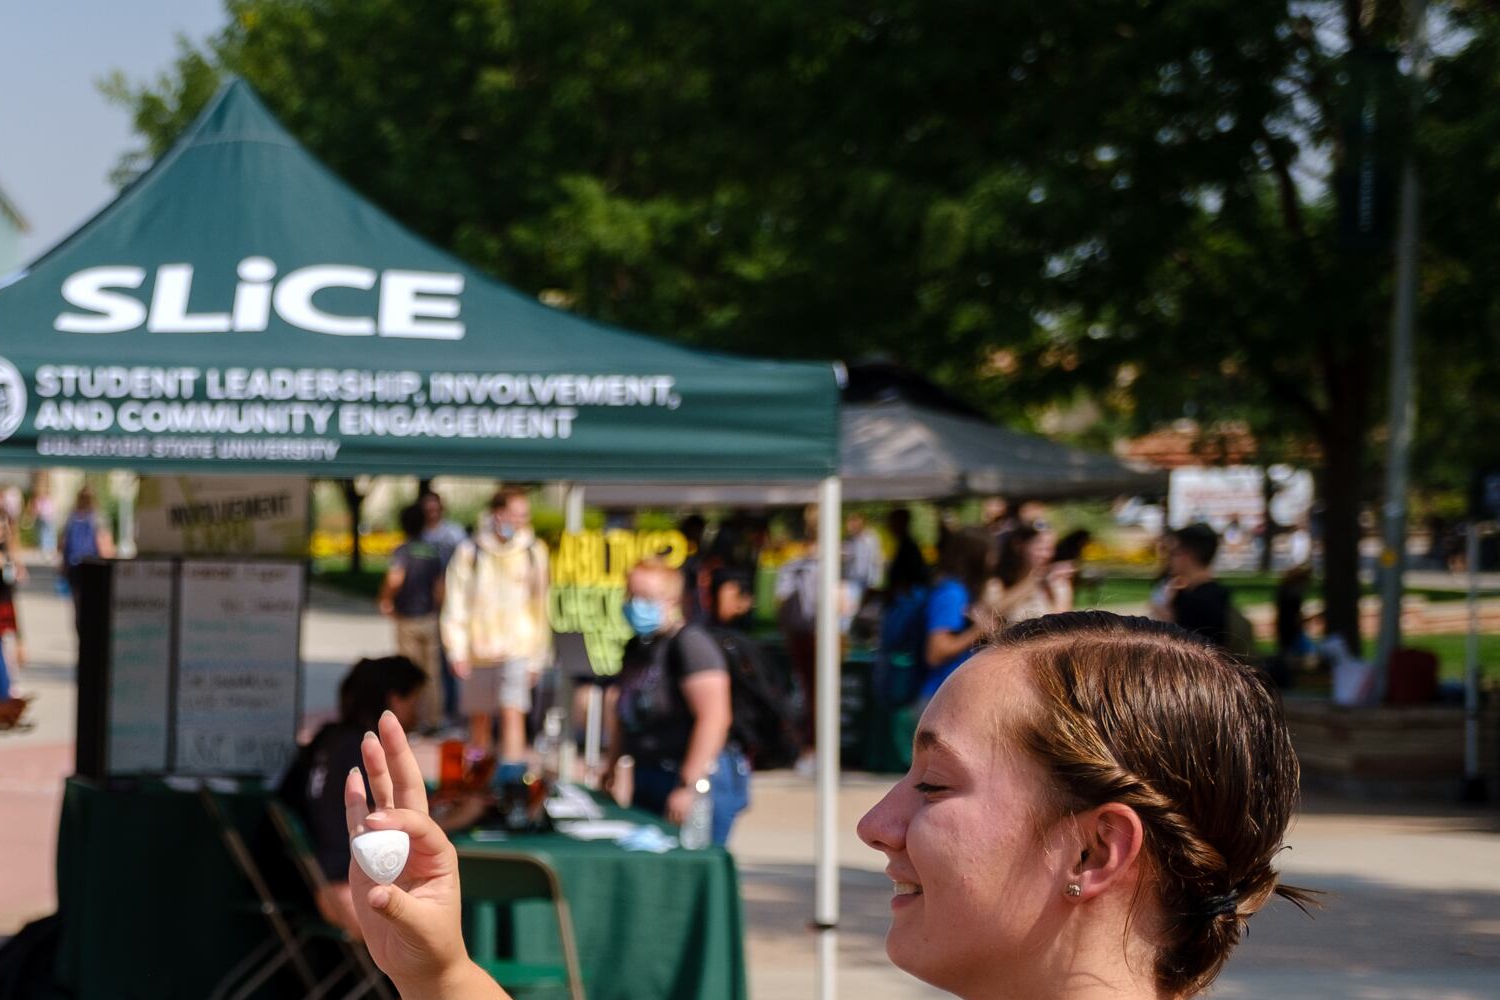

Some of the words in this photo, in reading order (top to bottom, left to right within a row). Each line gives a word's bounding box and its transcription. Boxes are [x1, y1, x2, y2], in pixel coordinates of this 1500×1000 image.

[34, 365, 200, 399] STUDENT
[206, 368, 426, 406] LEADERSHIP,
[429, 372, 682, 410] INVOLVEMENT,
[34, 402, 115, 432] AND
[117, 402, 335, 435] COMMUNITY
[338, 406, 578, 439] ENGAGEMENT
[216, 438, 340, 461] UNIVERSITY
